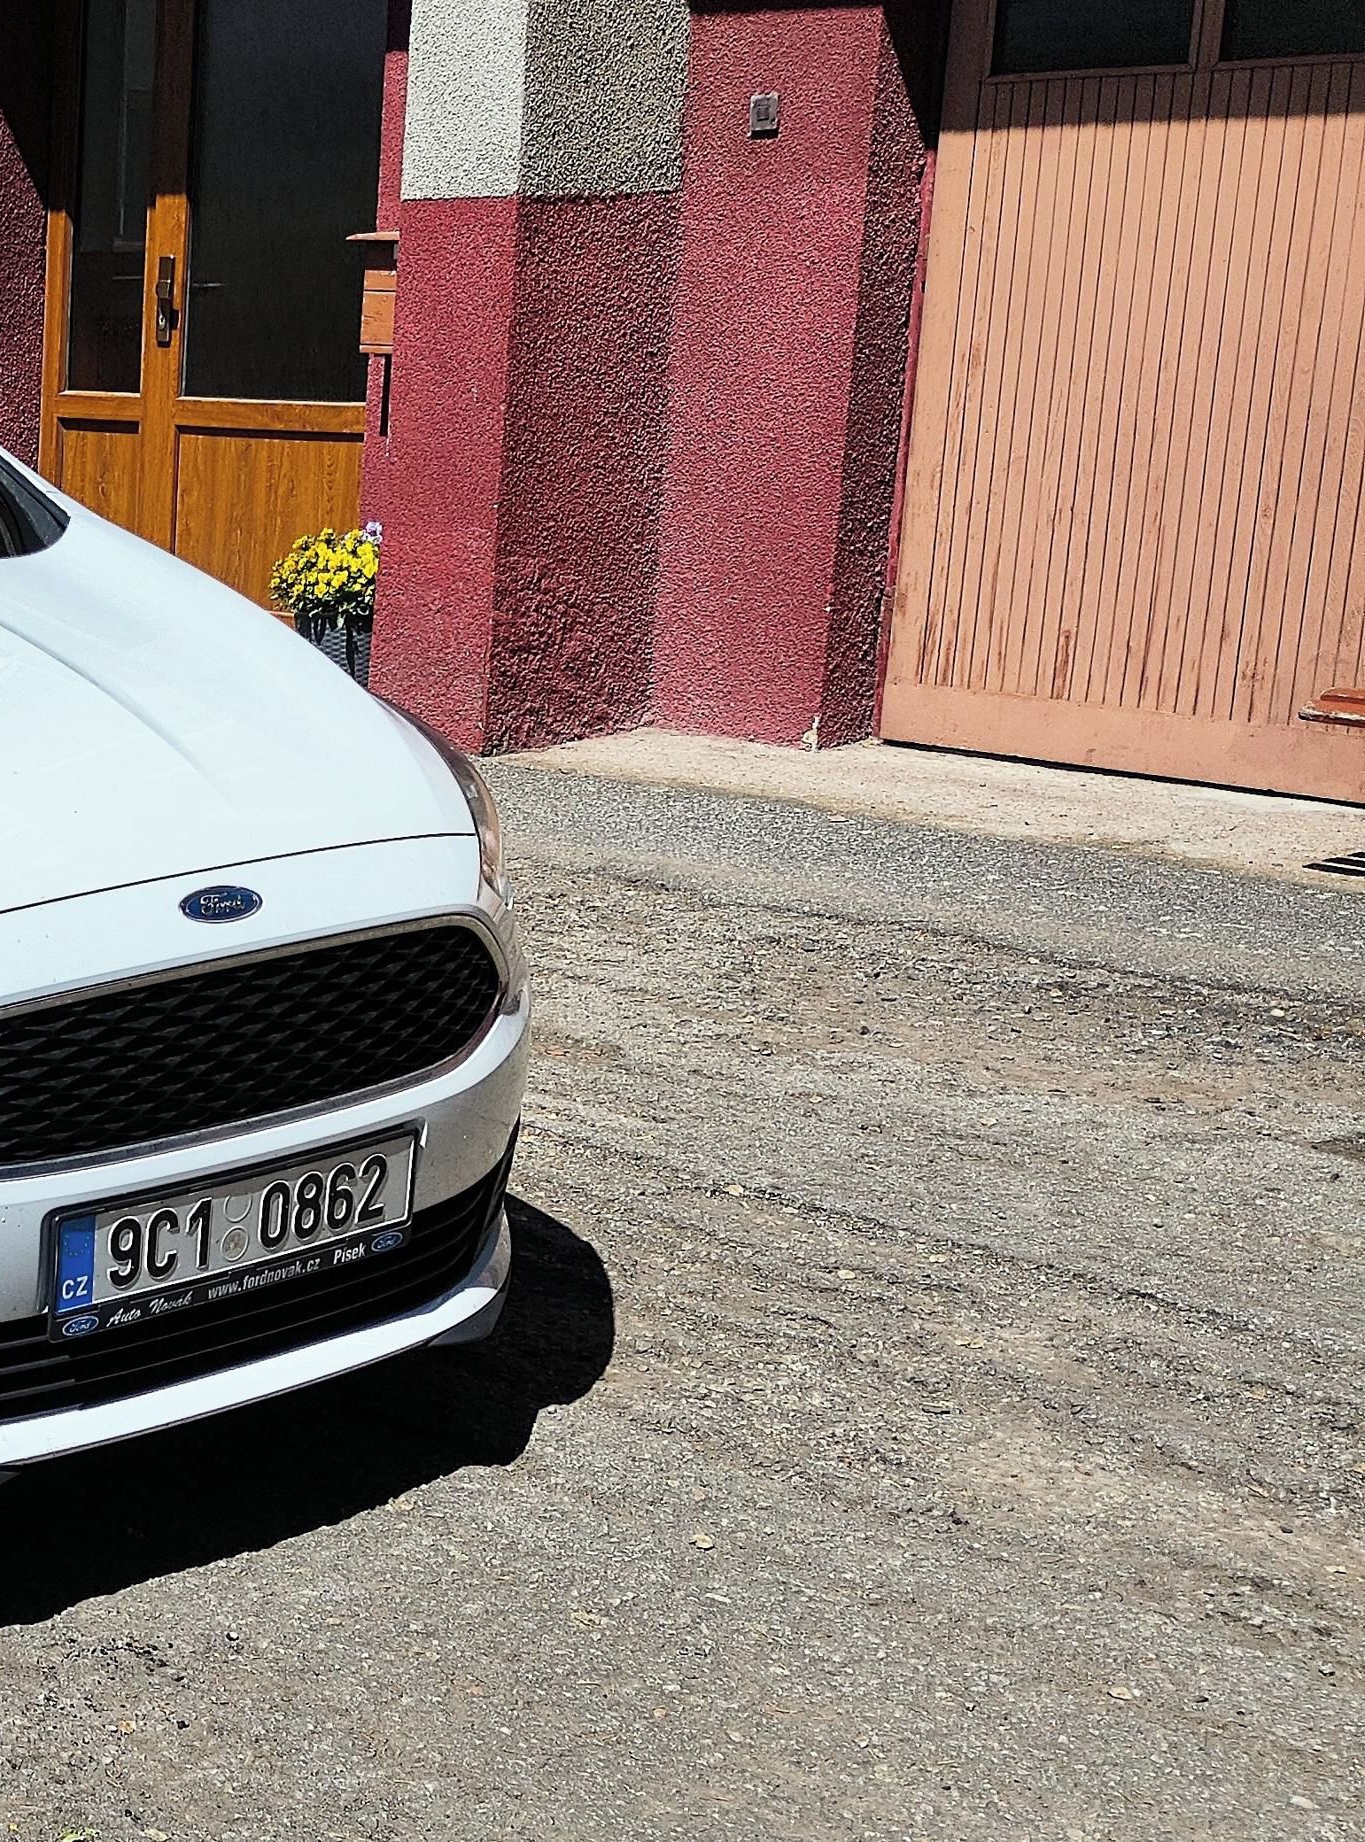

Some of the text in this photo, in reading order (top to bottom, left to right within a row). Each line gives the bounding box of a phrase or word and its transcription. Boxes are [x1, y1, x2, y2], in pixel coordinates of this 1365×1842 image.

[199, 892, 245, 915] Ford
[107, 1154, 388, 1289] 9C1 0862
[62, 1275, 89, 1300] CZ
[207, 1257, 322, 1300] www.fordnovak.cz
[106, 1308, 142, 1328] Auto
